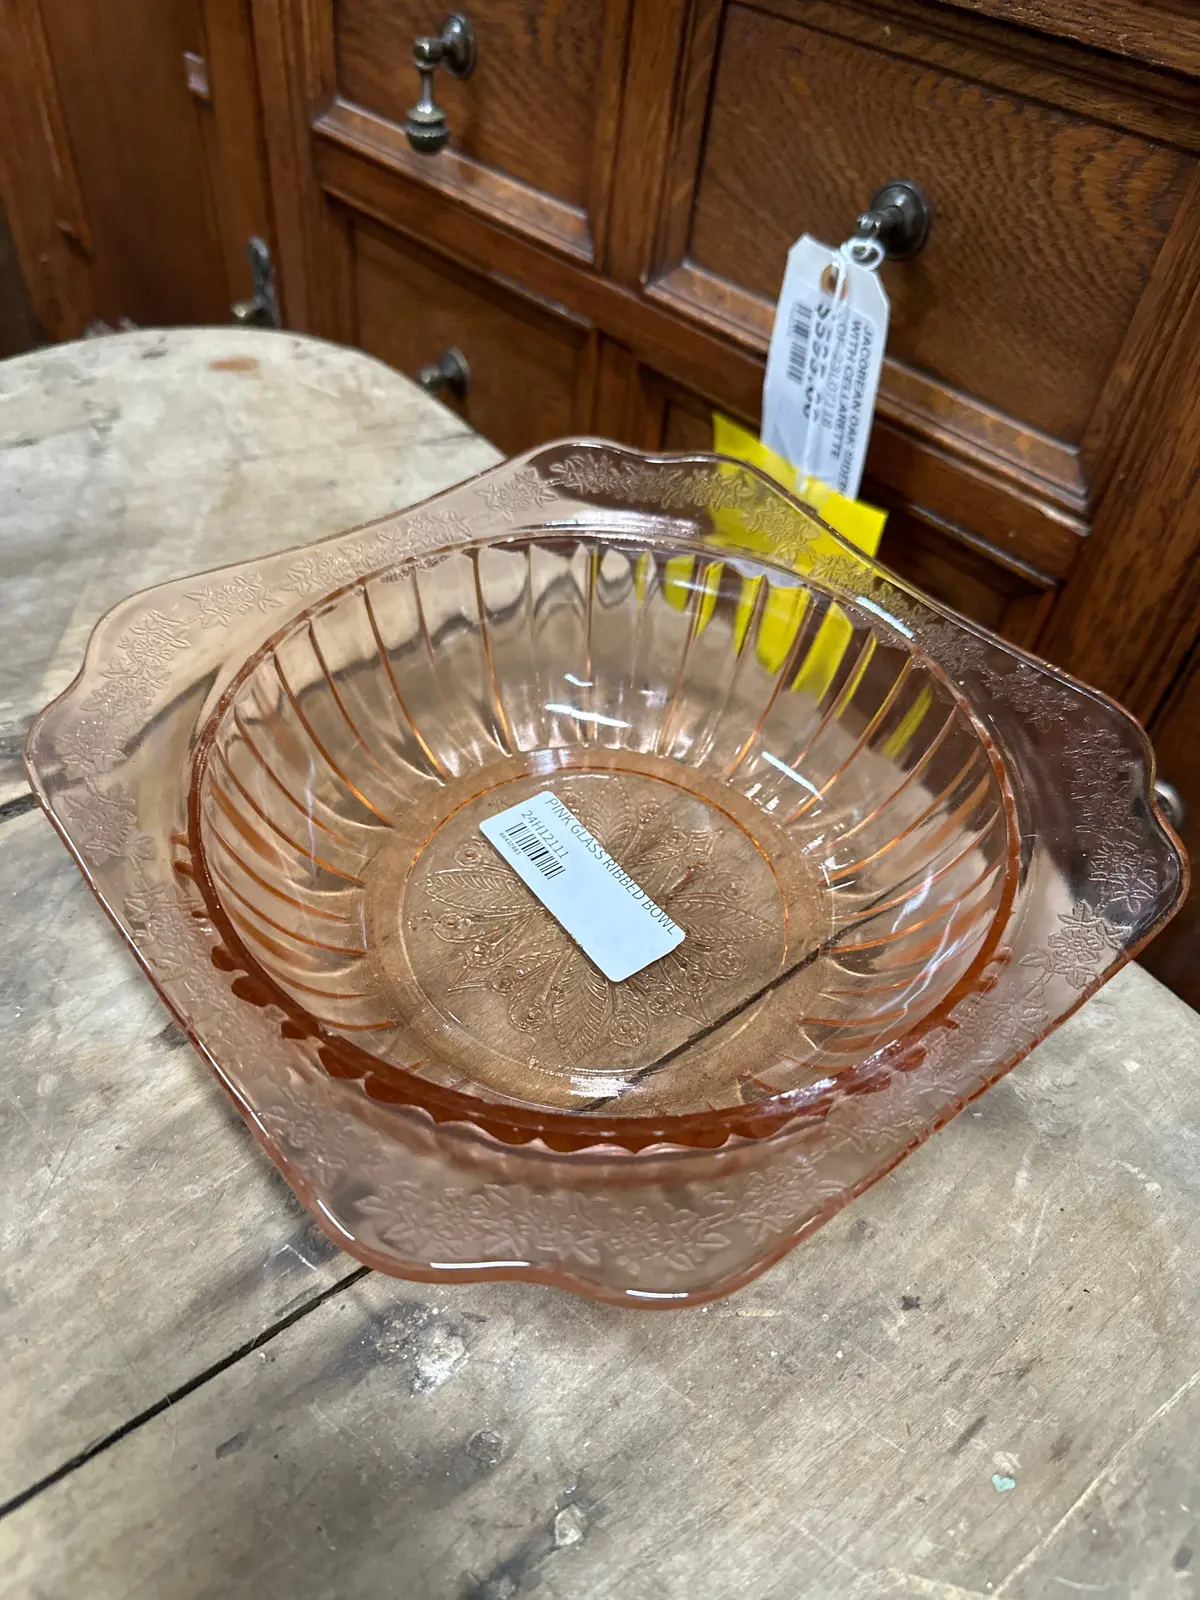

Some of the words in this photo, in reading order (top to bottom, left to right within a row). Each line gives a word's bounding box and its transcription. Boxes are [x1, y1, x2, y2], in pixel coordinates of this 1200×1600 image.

[847, 319, 863, 362] WITH
[853, 325, 875, 413] JACOBEAN
[830, 365, 854, 460] CELLARETTE
[845, 416, 860, 447] OAK
[521, 809, 569, 859] 24H12111
[545, 797, 574, 827] PINK
[571, 824, 606, 860] GLASS
[603, 858, 646, 901] RIBBED
[641, 899, 678, 935] BOWL
